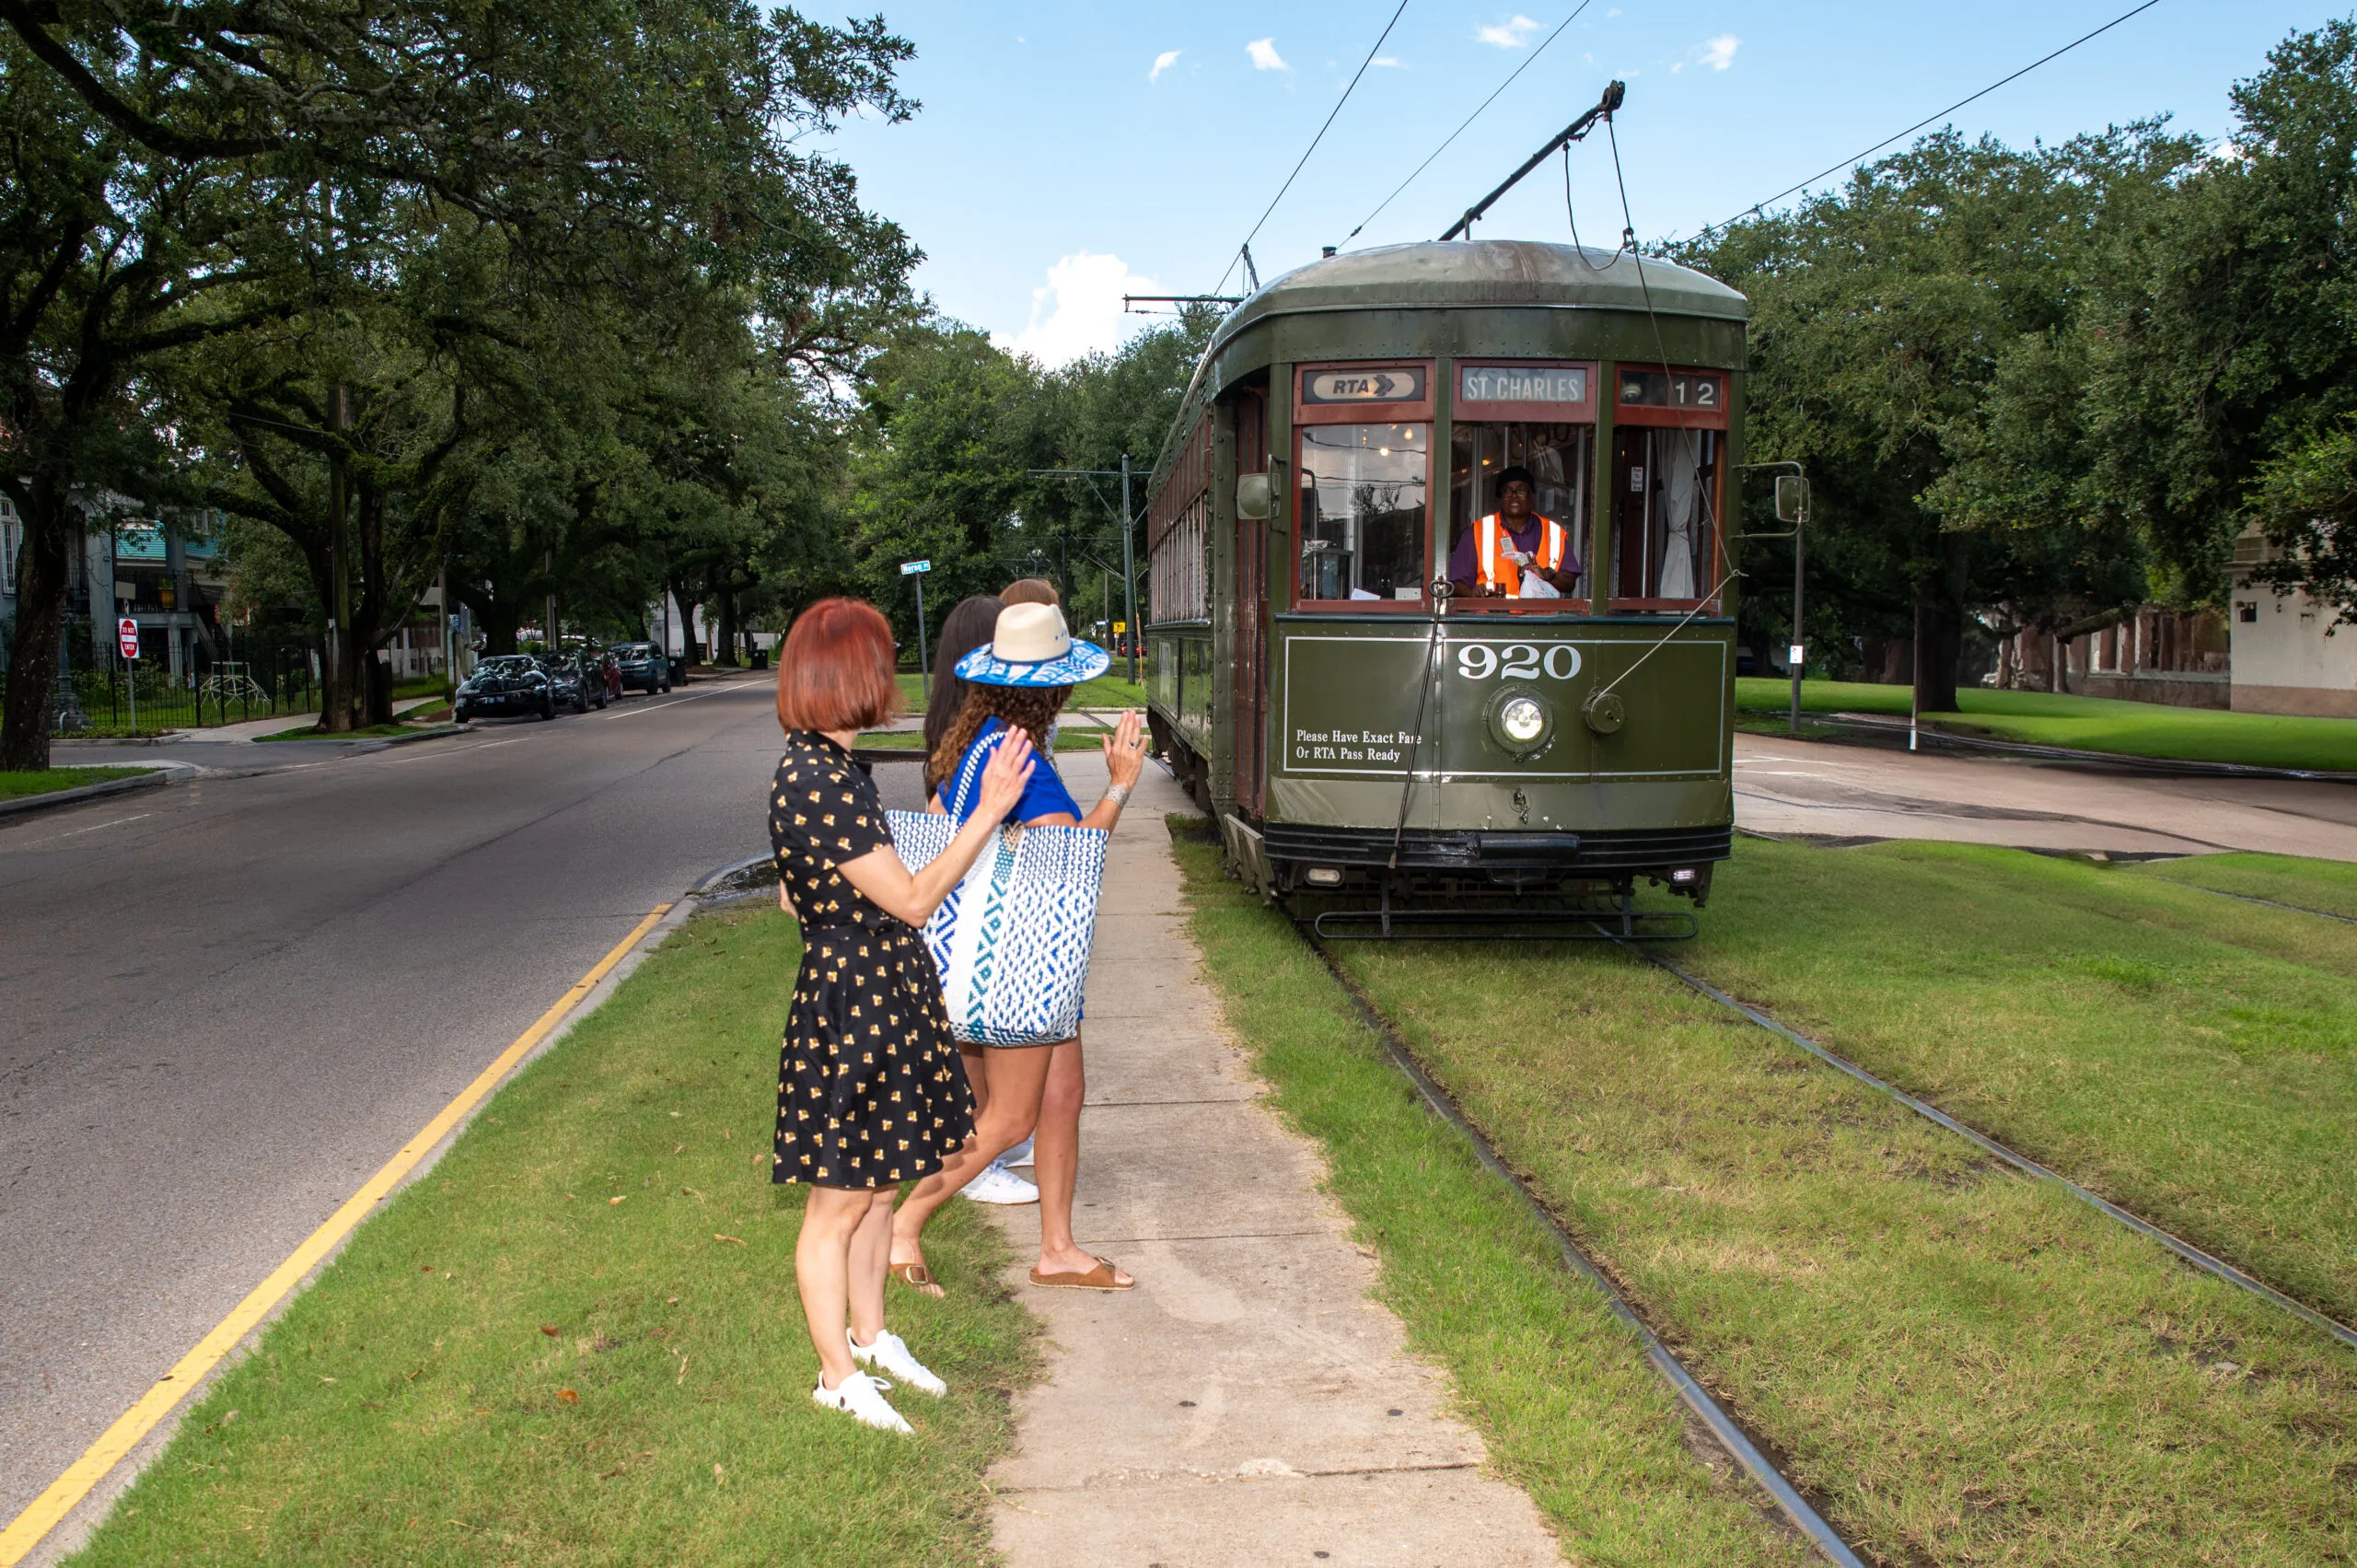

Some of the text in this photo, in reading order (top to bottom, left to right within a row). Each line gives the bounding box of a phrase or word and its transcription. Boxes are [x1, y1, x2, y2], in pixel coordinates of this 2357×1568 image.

[1333, 379, 1369, 394] RTA
[1468, 377, 1578, 401] ST. CHARLES
[1457, 645, 1582, 679] 920
[1296, 729, 1328, 742] Please
[1332, 730, 1358, 743] Have
[1363, 730, 1394, 744] Exact
[1295, 746, 1401, 763] Or RTA Pass Ready
